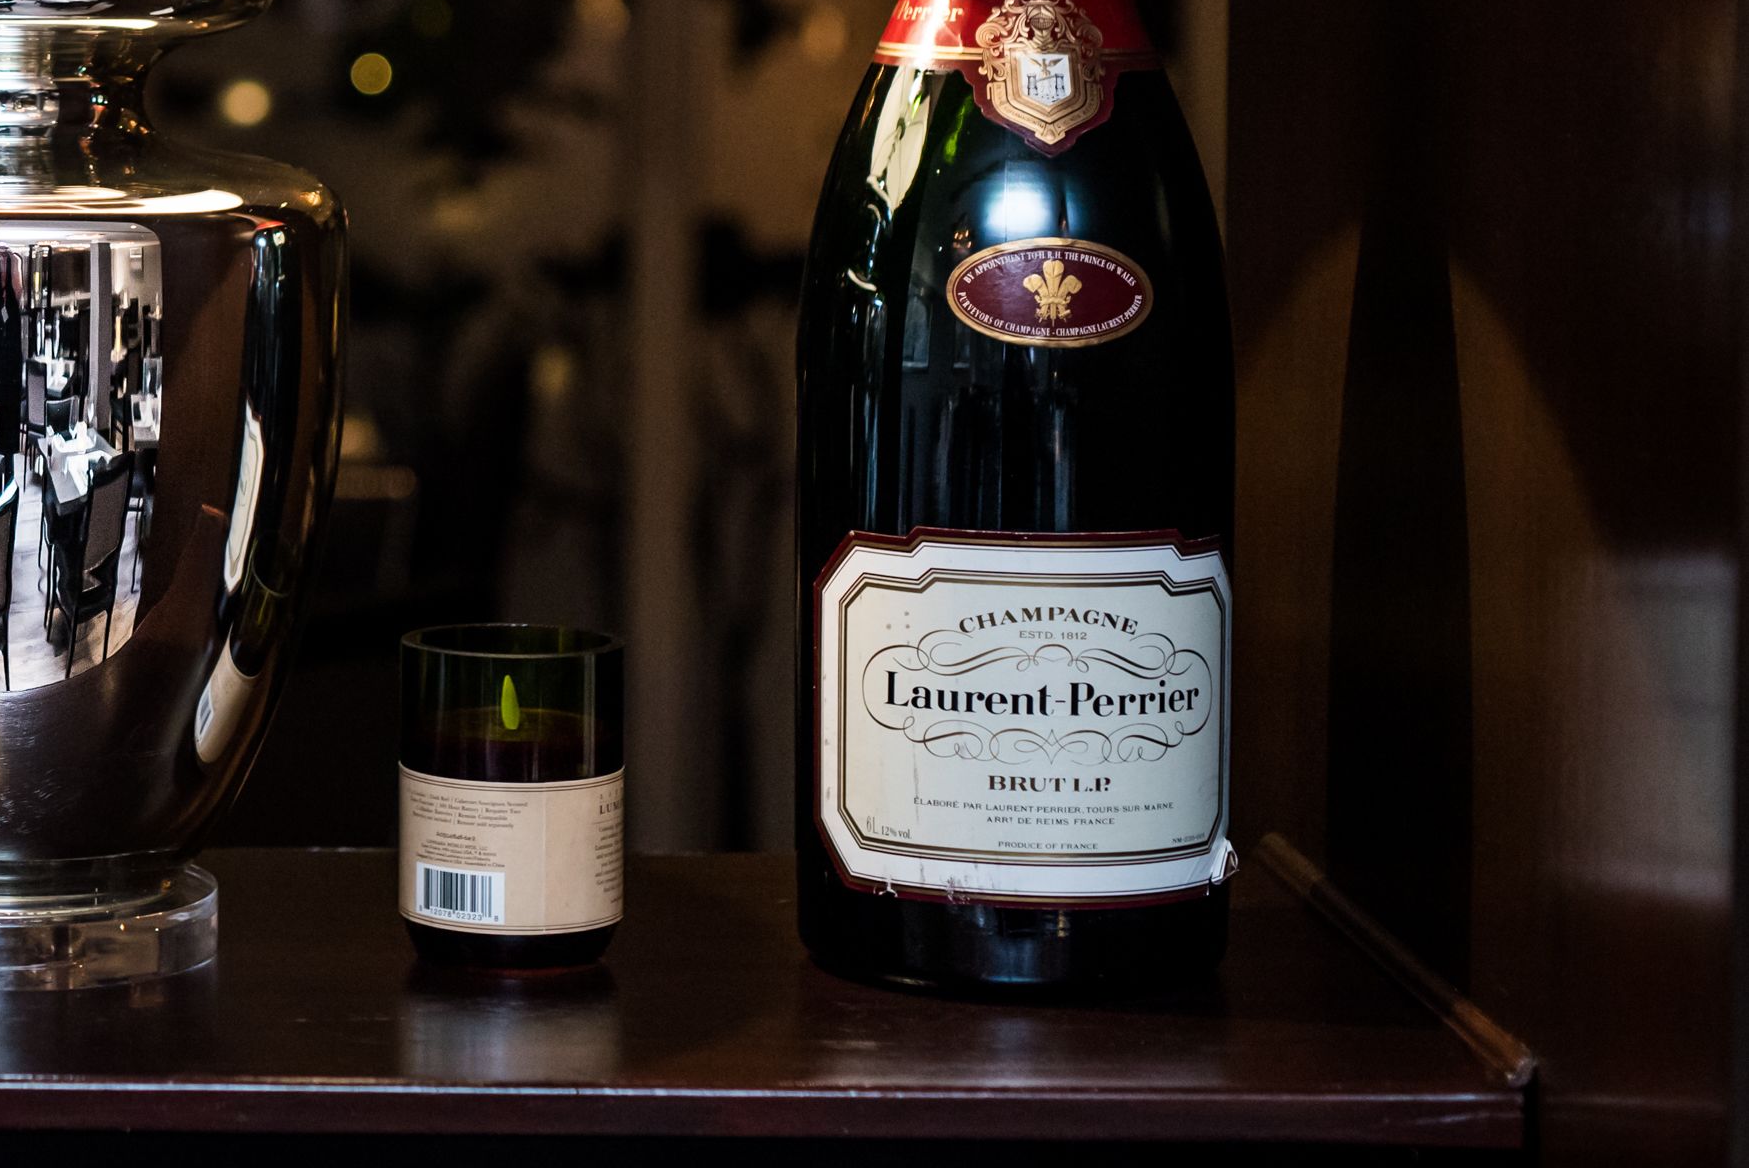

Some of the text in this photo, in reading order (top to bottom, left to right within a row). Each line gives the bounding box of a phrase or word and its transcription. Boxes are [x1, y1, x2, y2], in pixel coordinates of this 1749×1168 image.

[962, 271, 975, 284] BY
[974, 252, 1025, 276] APPOINTMENT
[1064, 251, 1079, 262] THE
[1080, 253, 1107, 268] PRINCE
[1106, 261, 1117, 272] OF
[1116, 266, 1137, 287] WALES
[957, 291, 993, 325] PURVEYORS
[993, 318, 1004, 329] OF
[1004, 321, 1050, 337] CHAMPAGNE
[1055, 324, 1097, 337] CHAMPAGNE
[1096, 294, 1143, 332] LAURENT-PERRIER
[958, 606, 1139, 635] CHAMPAGNE
[1018, 630, 1088, 641] ESTD. 1812
[884, 669, 1200, 718] Laurent-Perrier
[987, 775, 1067, 793] BRUT
[963, 801, 983, 811] PAR
[1017, 817, 1032, 825] DE
[1035, 817, 1070, 826] REIMS
[1073, 817, 1116, 826] FRANCE
[997, 841, 1099, 850] PRODUCE OF FRANCE
